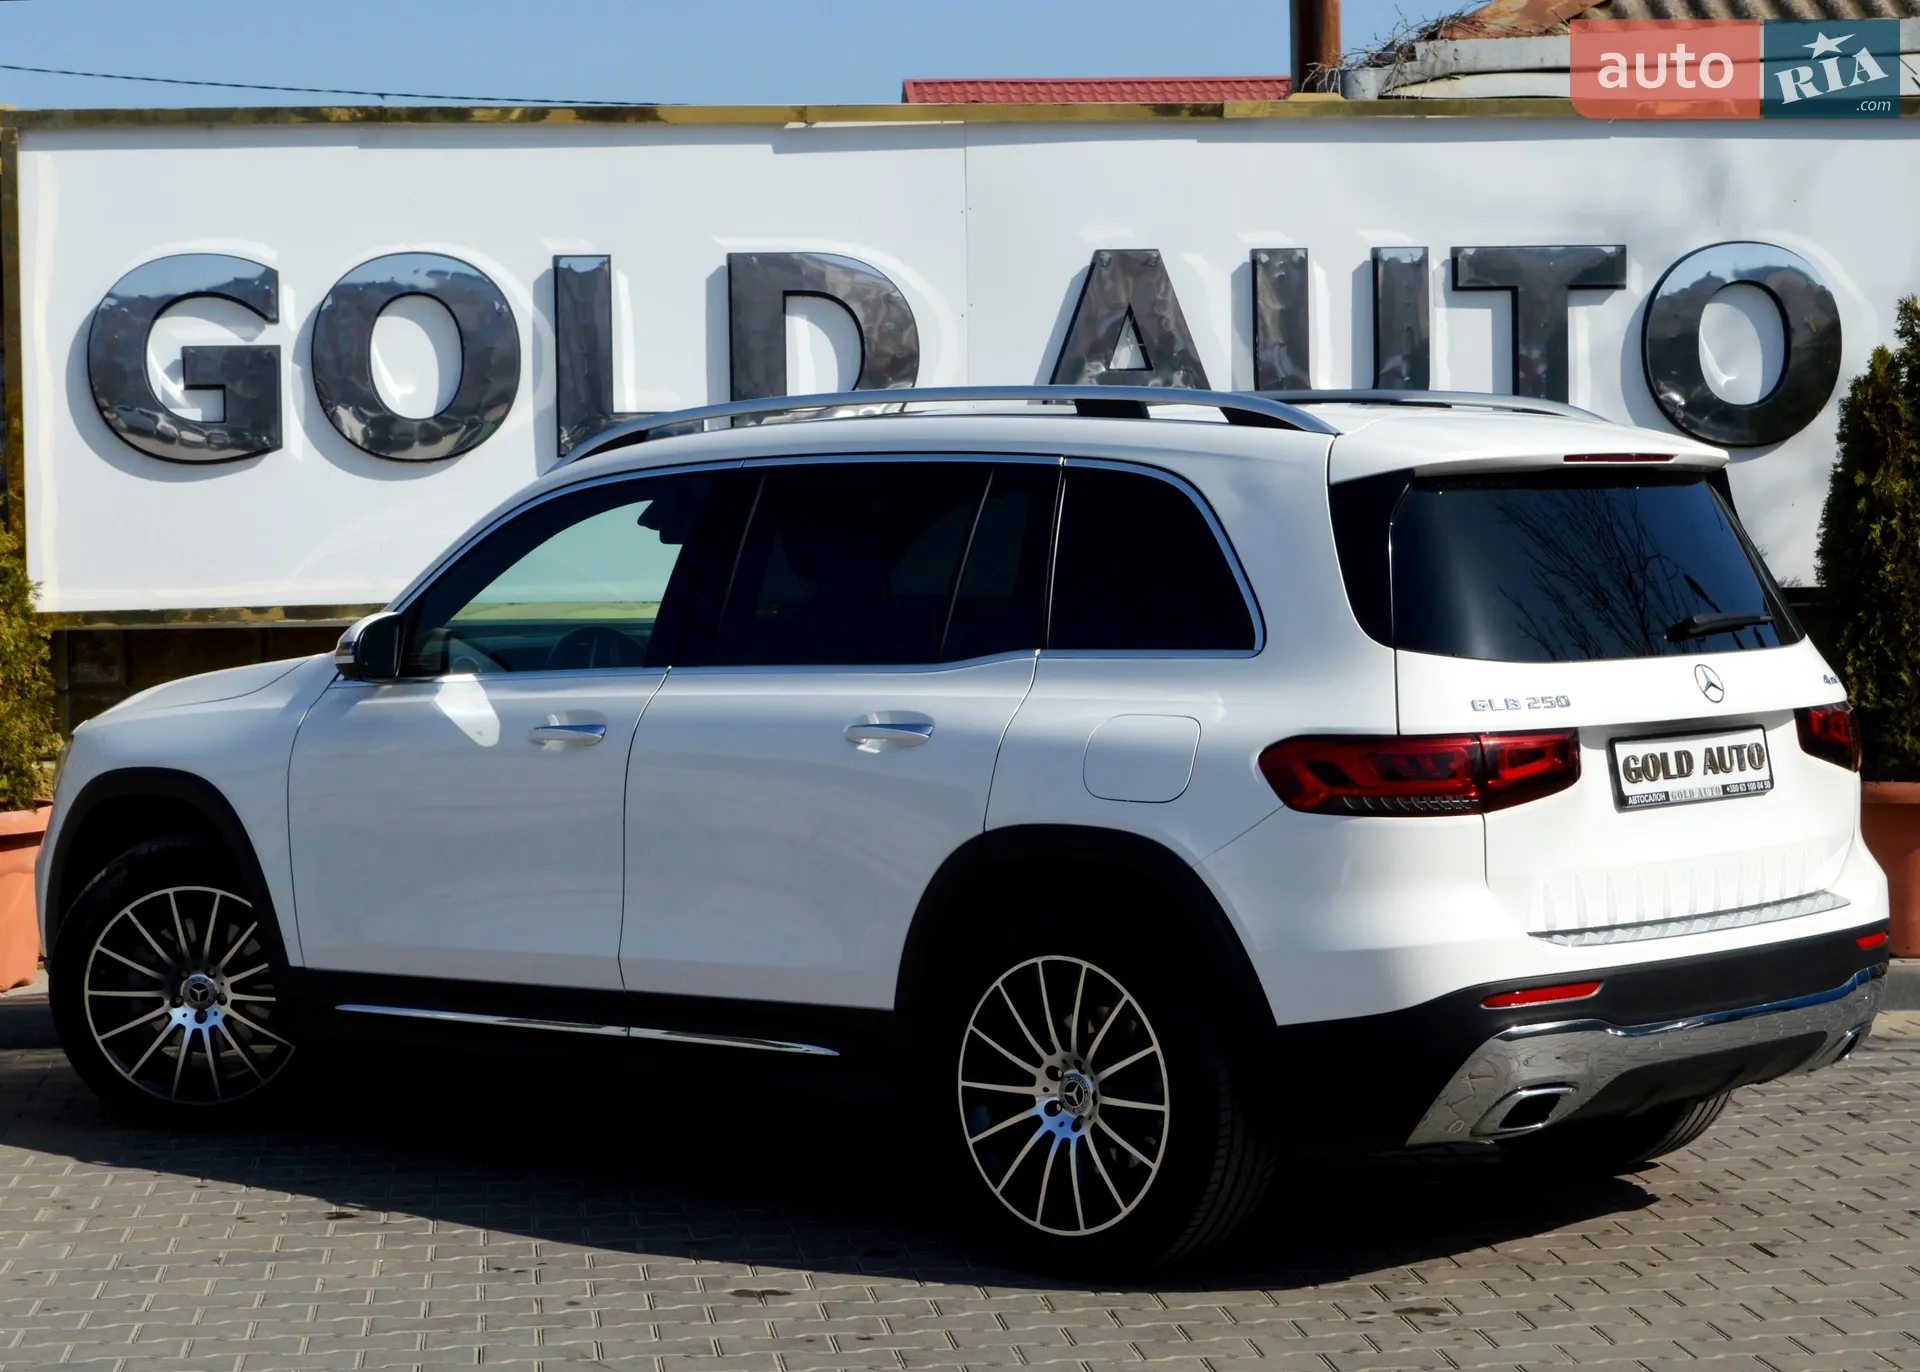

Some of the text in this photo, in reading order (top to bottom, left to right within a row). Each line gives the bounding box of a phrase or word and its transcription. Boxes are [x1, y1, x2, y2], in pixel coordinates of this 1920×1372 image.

[87, 240, 1842, 465] GOLD AUTO
[1470, 695, 1571, 712] GLB 250
[1622, 742, 1766, 784] GOLD AUTO
[1628, 792, 1666, 805] АВТОСАЛОН
[1671, 786, 1721, 800] GOLD AUTO
